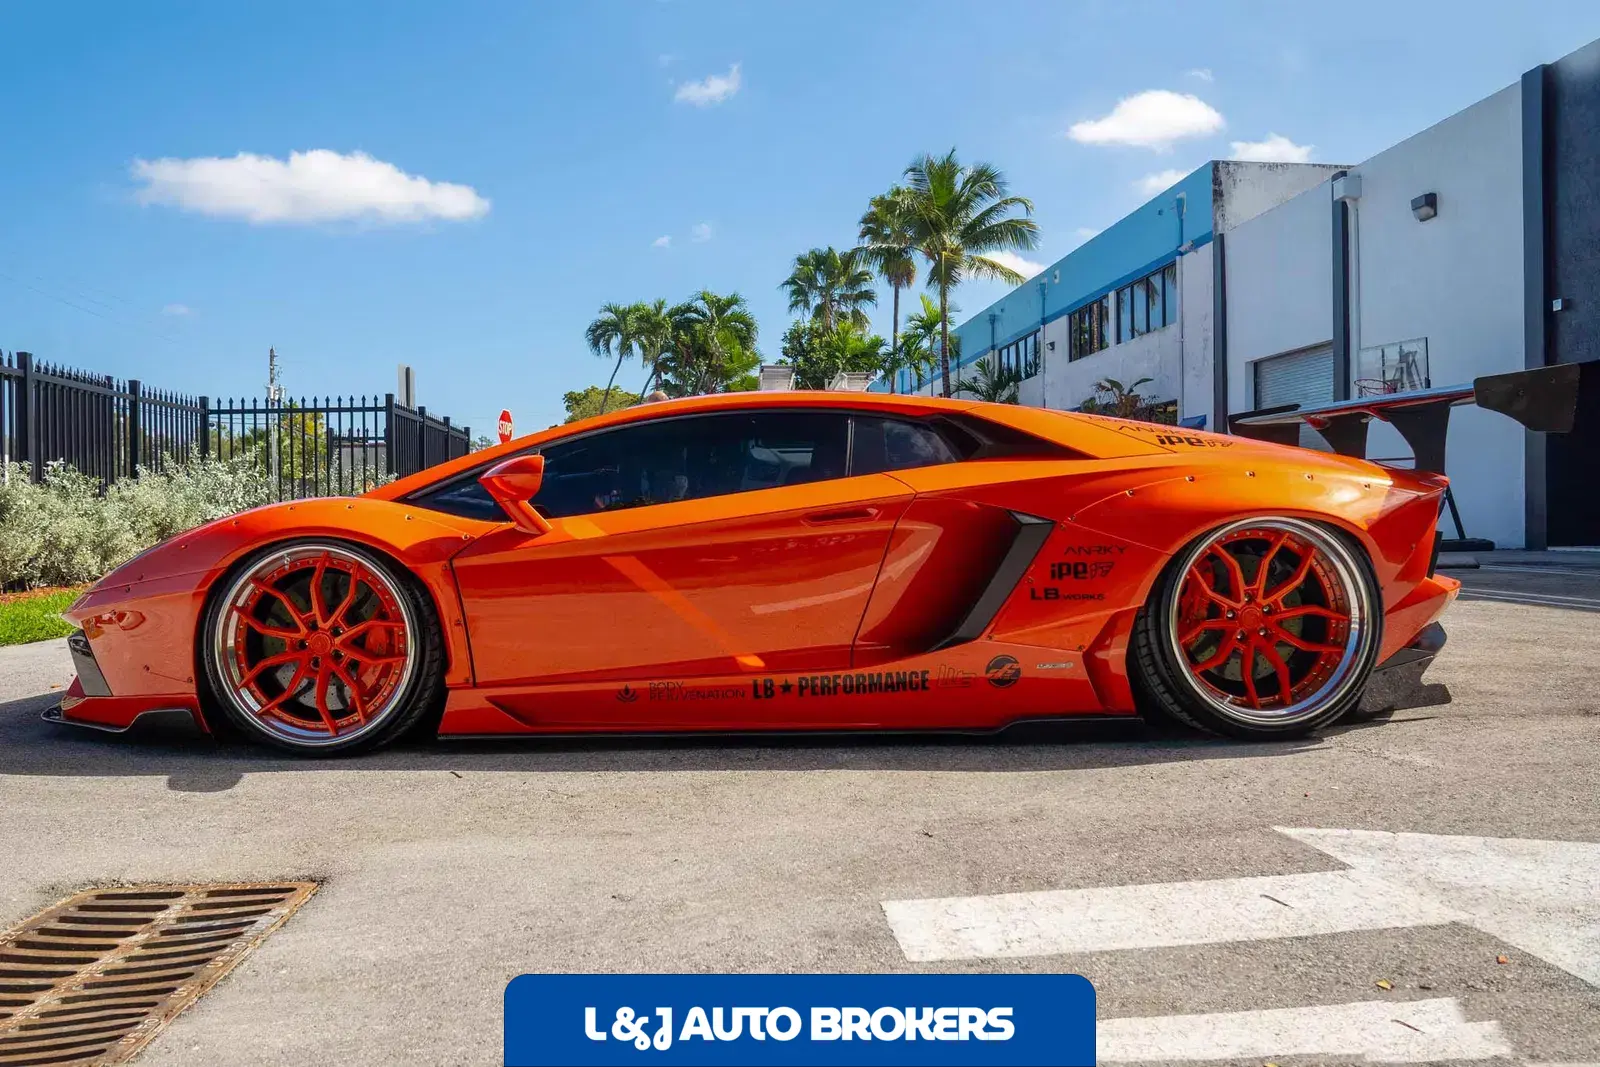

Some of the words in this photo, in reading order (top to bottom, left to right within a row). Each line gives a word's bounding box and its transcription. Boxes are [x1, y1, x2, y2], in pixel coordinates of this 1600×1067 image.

[499, 420, 512, 437] STOP
[1064, 544, 1129, 556] ANRKY
[1030, 587, 1060, 601] LB
[1062, 593, 1106, 601] WORKS
[649, 681, 684, 691] BODY
[752, 678, 775, 699] LB
[797, 670, 930, 697] PERFORMANCE
